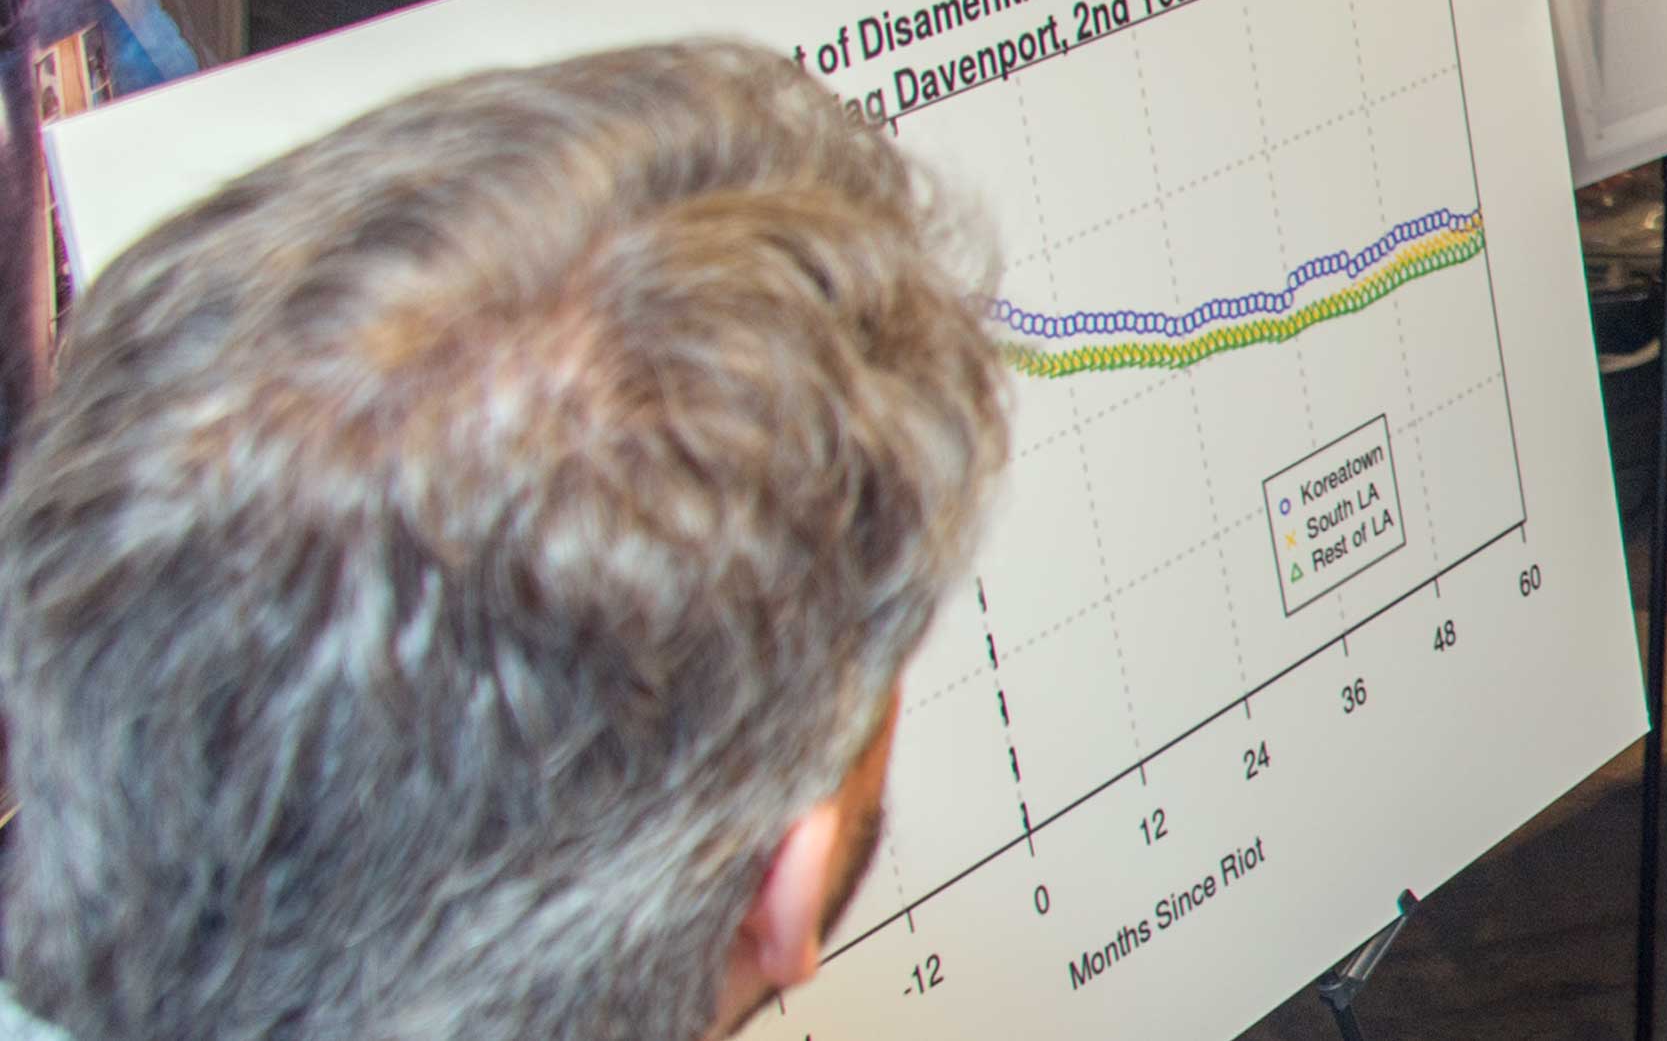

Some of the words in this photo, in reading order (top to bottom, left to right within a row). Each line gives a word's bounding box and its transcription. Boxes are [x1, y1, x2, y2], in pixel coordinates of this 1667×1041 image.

[818, 26, 851, 75] of
[894, 18, 1070, 110] Davenport,
[1300, 444, 1384, 506] Koreatown
[1306, 499, 1351, 541] South
[1355, 482, 1381, 516] LA
[1311, 535, 1347, 573] Rest
[1352, 523, 1370, 555] of
[1372, 508, 1395, 542] LA
[1519, 564, 1542, 598] 60
[1432, 620, 1458, 654] 48
[1341, 679, 1368, 715] 36
[1243, 742, 1271, 781] 24
[1140, 809, 1169, 848] 12
[1034, 886, 1051, 916] 0
[1067, 916, 1151, 991] Months
[1156, 873, 1217, 934] Since
[1220, 837, 1267, 904] Riot
[904, 954, 944, 994] -12
